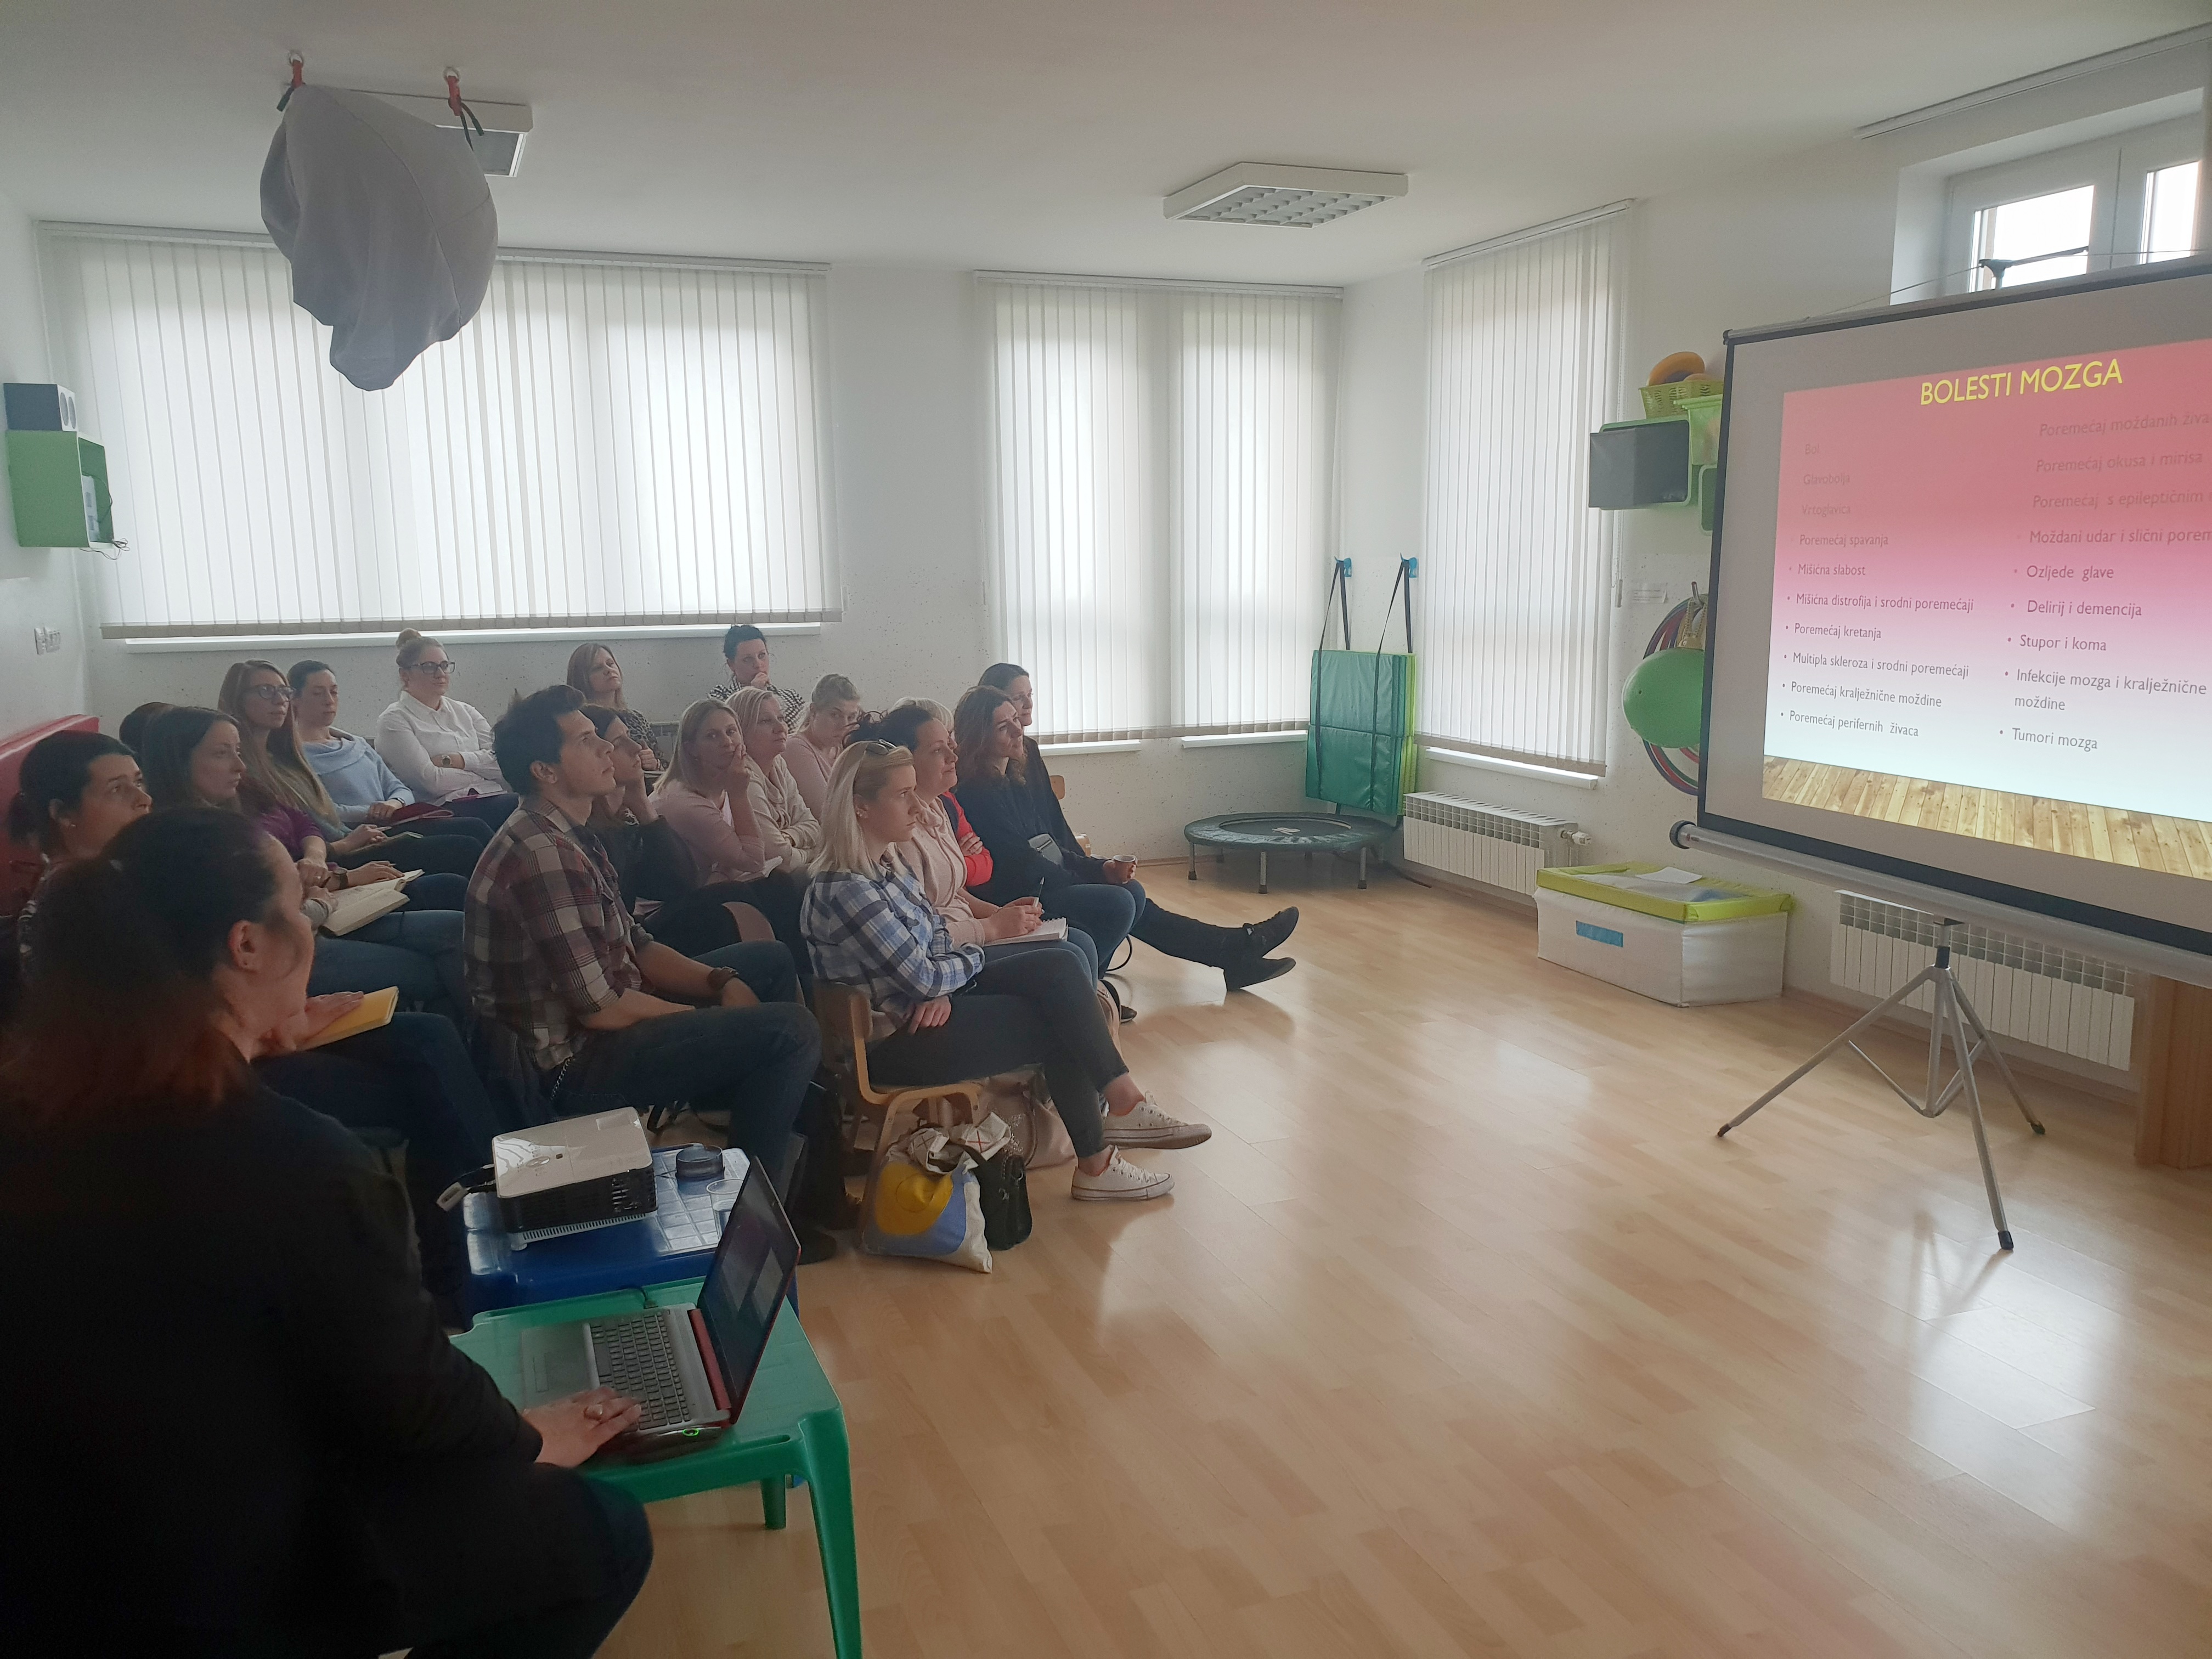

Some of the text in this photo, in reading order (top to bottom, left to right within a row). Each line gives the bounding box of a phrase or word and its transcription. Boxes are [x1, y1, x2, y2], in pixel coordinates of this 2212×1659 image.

[1921, 358, 2123, 405] BOLESTI MOZGA
[2039, 419, 2106, 436] Poremećaj
[2111, 414, 2177, 431] moždanih
[1804, 443, 1820, 455] Bol
[2036, 456, 2102, 472] Poremećaj
[2107, 454, 2146, 469] okusa
[2160, 451, 2203, 466] mirisa
[1803, 472, 1851, 486] Glavobolja
[2033, 493, 2099, 509] Poremećaj
[2119, 490, 2203, 508] epileptičnim
[1802, 503, 1851, 517] Vrtoglavica
[1799, 534, 1889, 548] Poremećaj spavanja
[2029, 529, 2082, 544] Moždani
[2087, 529, 2117, 543] udar
[2128, 528, 2163, 543] slični
[1798, 563, 1866, 575] Mišićna slabost
[2027, 565, 2114, 582] Ozljede glave
[1796, 592, 1829, 606] Mišićna
[1831, 595, 1871, 610] distrofija
[1881, 596, 1912, 608] srodni
[1915, 597, 1974, 614] poremećaji
[2027, 600, 2064, 617] Delirij
[2076, 601, 2142, 619] demencija
[1795, 623, 1882, 641] Poremećaj kretanja
[2019, 634, 2061, 651] Stupor
[2072, 636, 2107, 651] koma
[1793, 652, 1827, 668] Multipla
[1830, 655, 1868, 669] skleroza
[1877, 659, 1908, 672] srodni
[1911, 663, 1969, 680] poremećaji
[2017, 668, 2066, 687] Infekcije
[2070, 675, 2111, 691] mozga
[2124, 676, 2207, 695] kralježnične
[1791, 681, 1942, 707] Poremećaj kralježnične moždine
[2014, 695, 2066, 711] moždine
[1790, 710, 1918, 737] Poremećaj perifernih živaca
[2012, 727, 2098, 752] Tumori mozga
